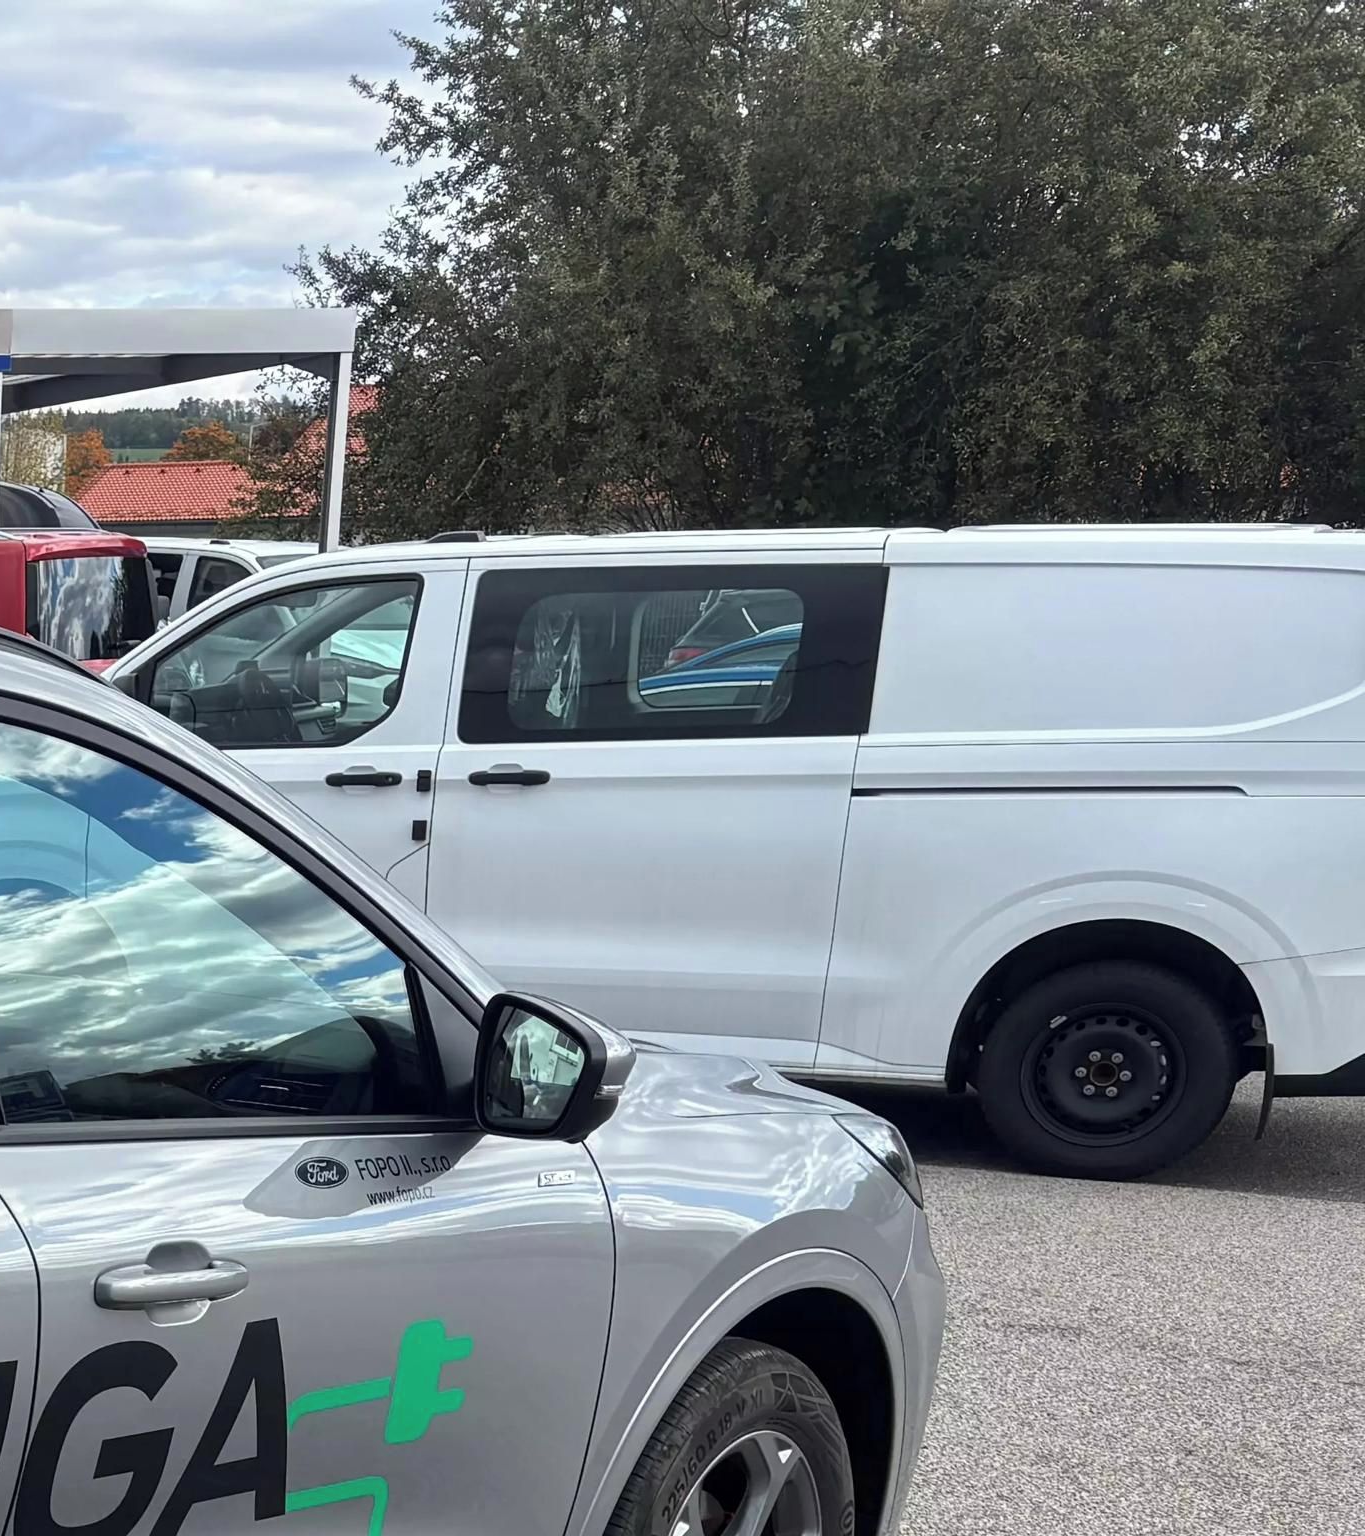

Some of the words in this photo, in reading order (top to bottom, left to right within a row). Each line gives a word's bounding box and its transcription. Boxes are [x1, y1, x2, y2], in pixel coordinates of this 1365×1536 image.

[306, 1161, 340, 1184] Ford
[354, 1155, 401, 1181] FOPO
[366, 1185, 436, 1206] www.fopo.cz
